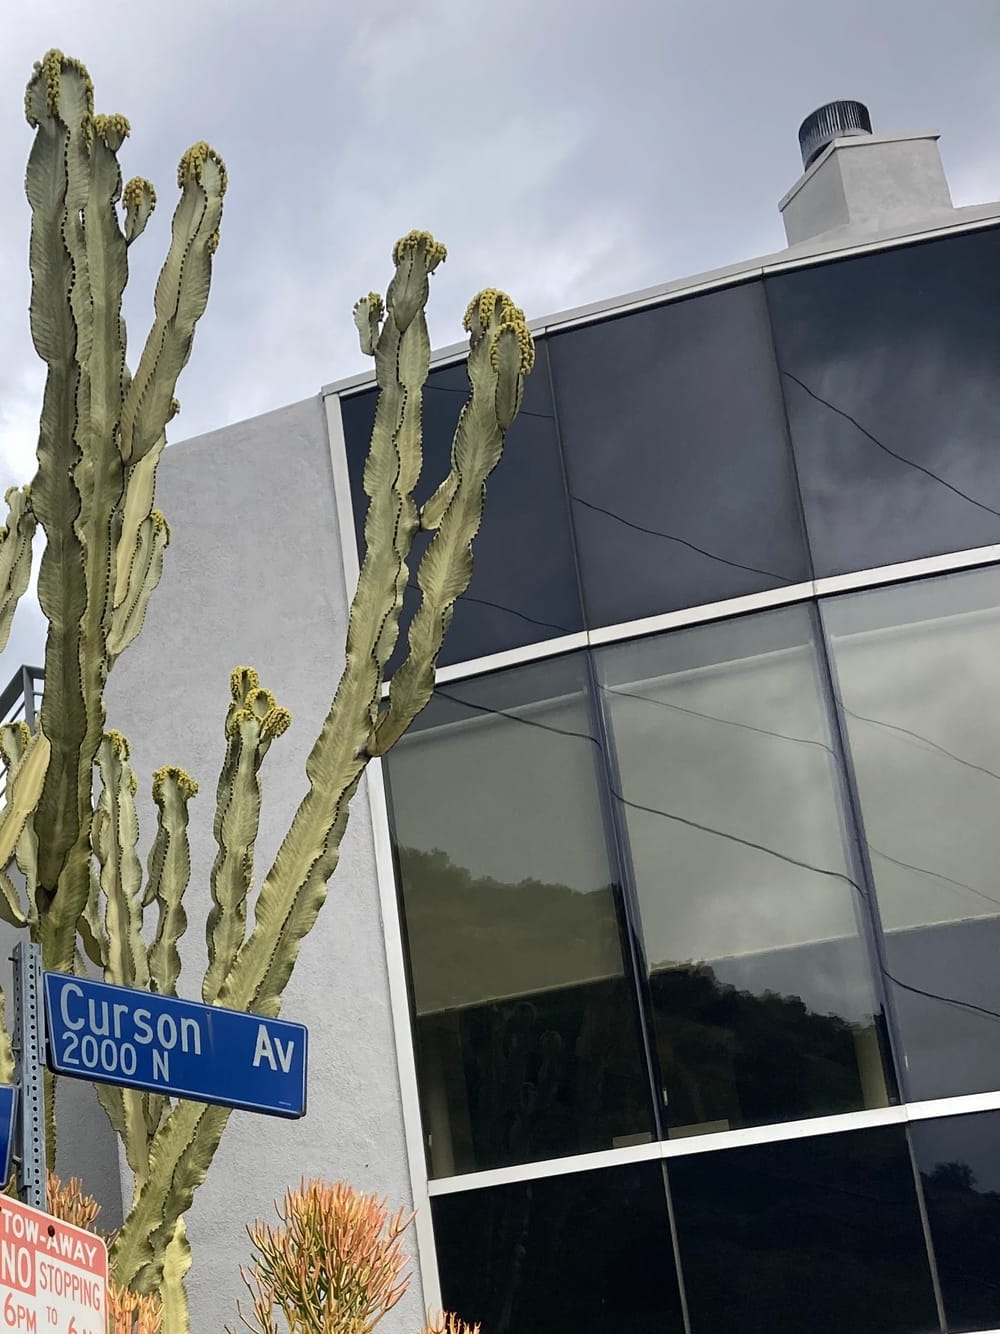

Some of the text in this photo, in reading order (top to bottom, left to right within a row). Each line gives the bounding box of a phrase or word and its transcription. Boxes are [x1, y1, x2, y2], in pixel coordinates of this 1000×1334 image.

[60, 983, 294, 1073] Curson Av
[62, 1031, 170, 1083] 2000 N
[1, 1208, 98, 1268] TOW-AWAY
[1, 1240, 101, 1312] NO STOPPING
[45, 1306, 58, 1326] TO
